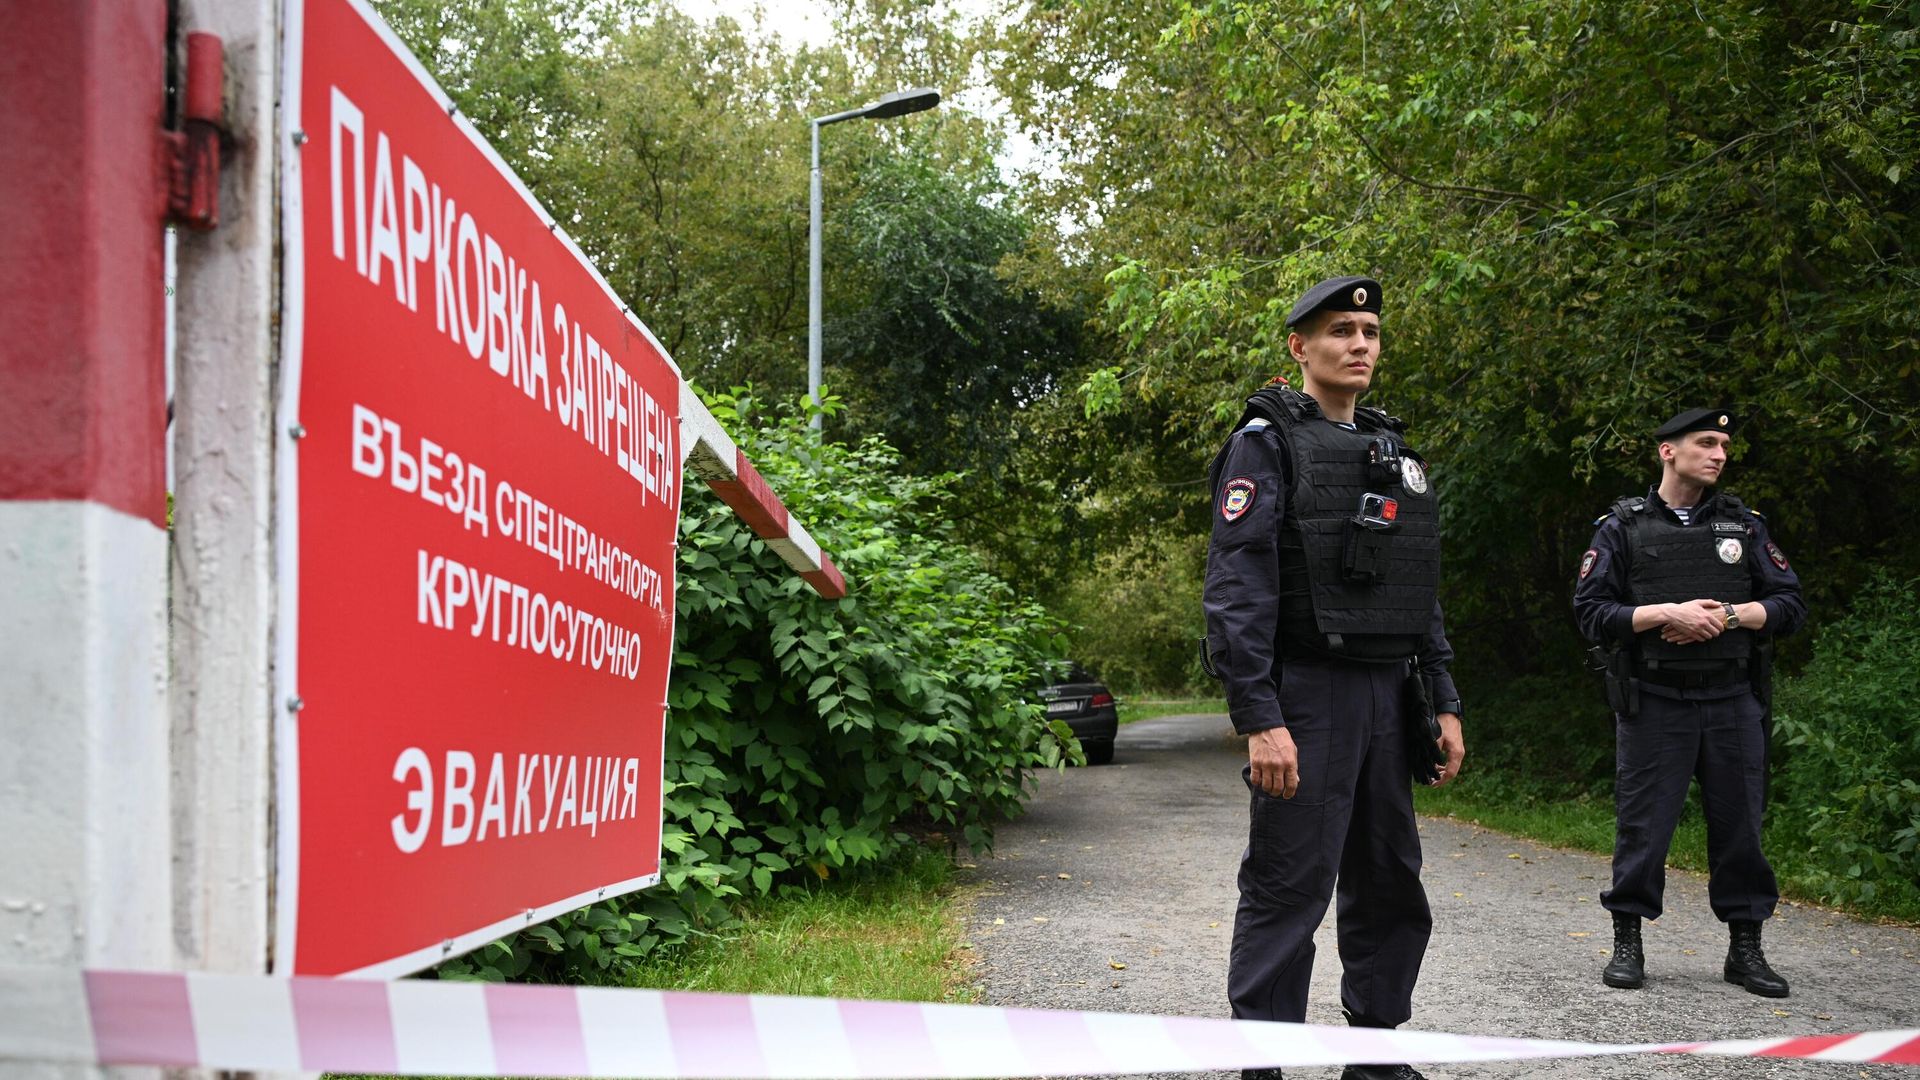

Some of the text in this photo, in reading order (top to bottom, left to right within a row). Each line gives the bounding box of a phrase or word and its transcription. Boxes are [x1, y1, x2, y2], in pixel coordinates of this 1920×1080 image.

[331, 85, 674, 510] ПАРКОВКА ЗАПРЕЩЕНА
[352, 404, 663, 613] ВЪЕЗД СПЕЦТРАНСПОРТА
[417, 549, 641, 681] КРУГЛОСУТОЧНО
[390, 747, 639, 854] ЭВАКУАЦИЯ
